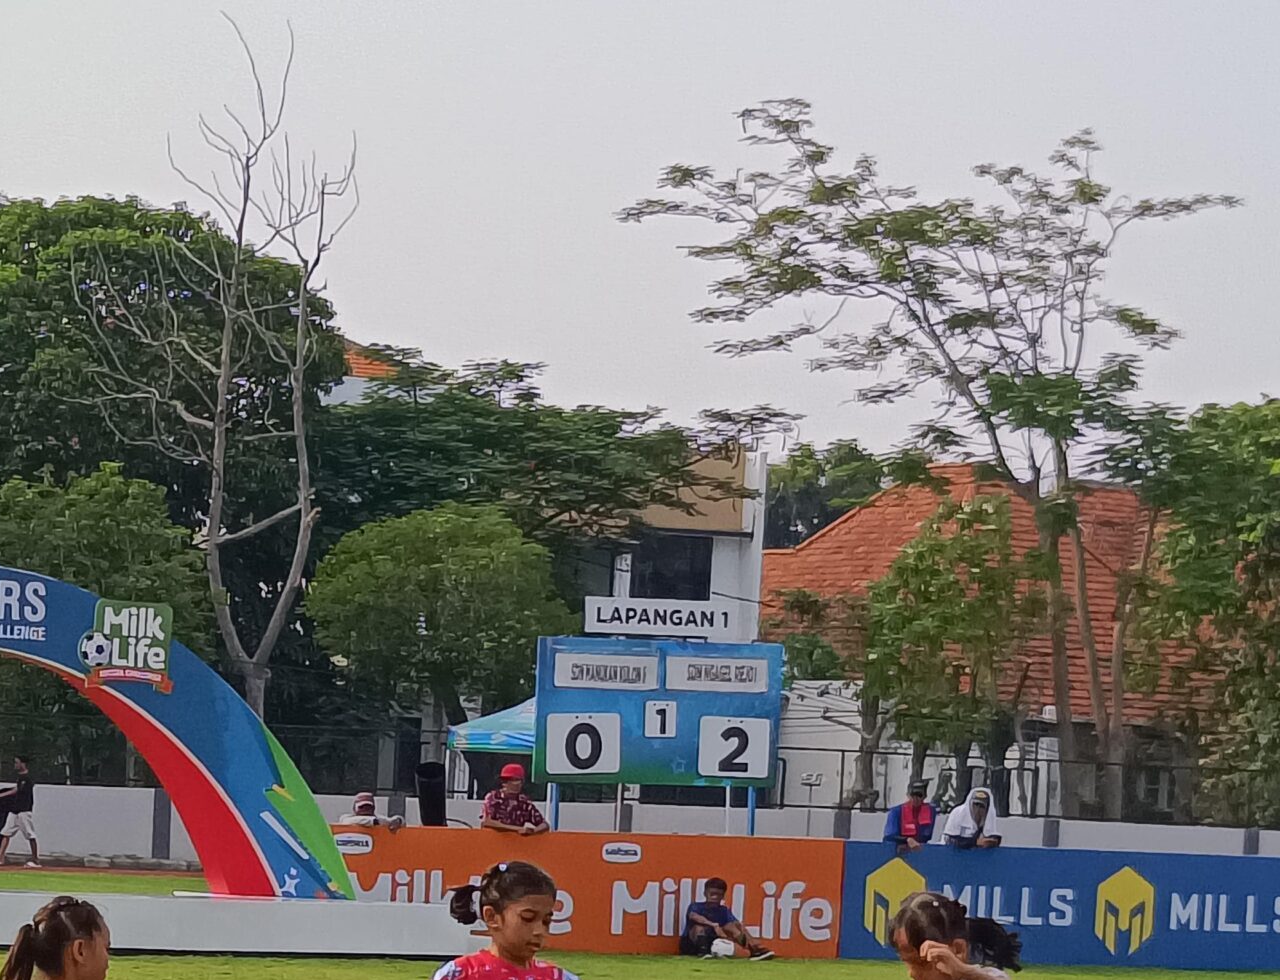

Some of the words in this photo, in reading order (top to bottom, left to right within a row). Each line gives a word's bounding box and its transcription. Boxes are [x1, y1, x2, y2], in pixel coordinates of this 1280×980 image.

[104, 606, 165, 640] Milk
[596, 607, 715, 628] LAPANGAN
[721, 612, 729, 628] 1
[112, 637, 165, 669] Life
[655, 708, 667, 735] 1
[565, 723, 603, 770] 0
[718, 727, 749, 773] 2
[611, 877, 833, 941] MilLife
[943, 884, 1074, 927] MILLS
[1170, 892, 1280, 933] MILL
